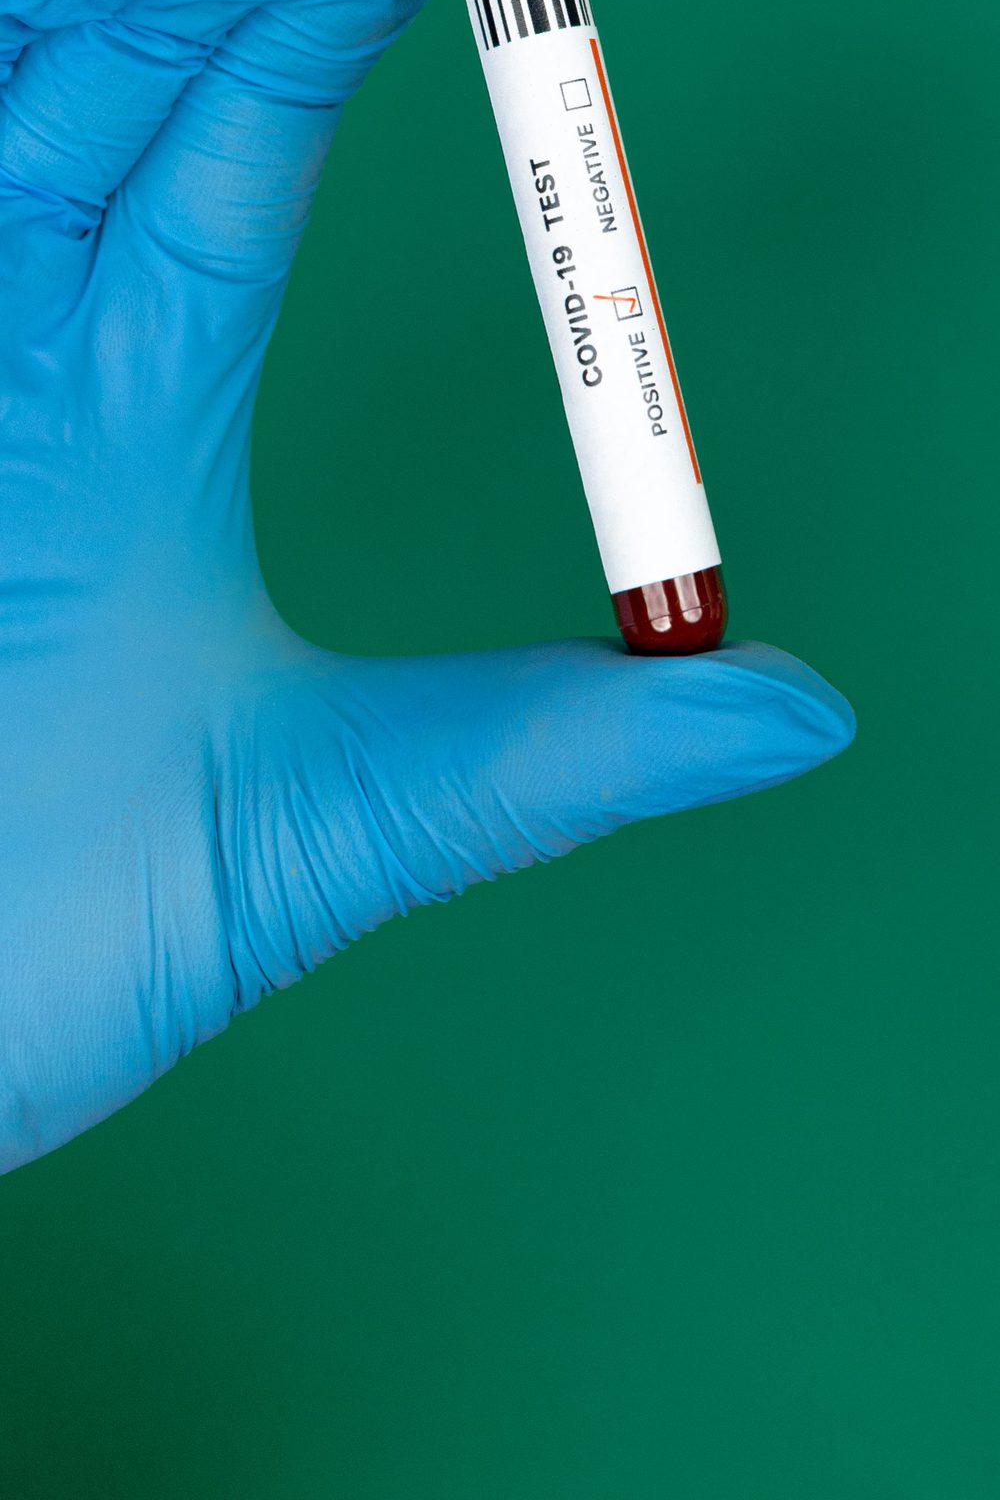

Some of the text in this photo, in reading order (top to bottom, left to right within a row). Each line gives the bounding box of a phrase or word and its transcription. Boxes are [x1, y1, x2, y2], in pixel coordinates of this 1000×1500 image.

[577, 123, 617, 234] NEGATIVE
[530, 158, 603, 387] COVID-19 TEST
[629, 331, 667, 437] POSITIVE
